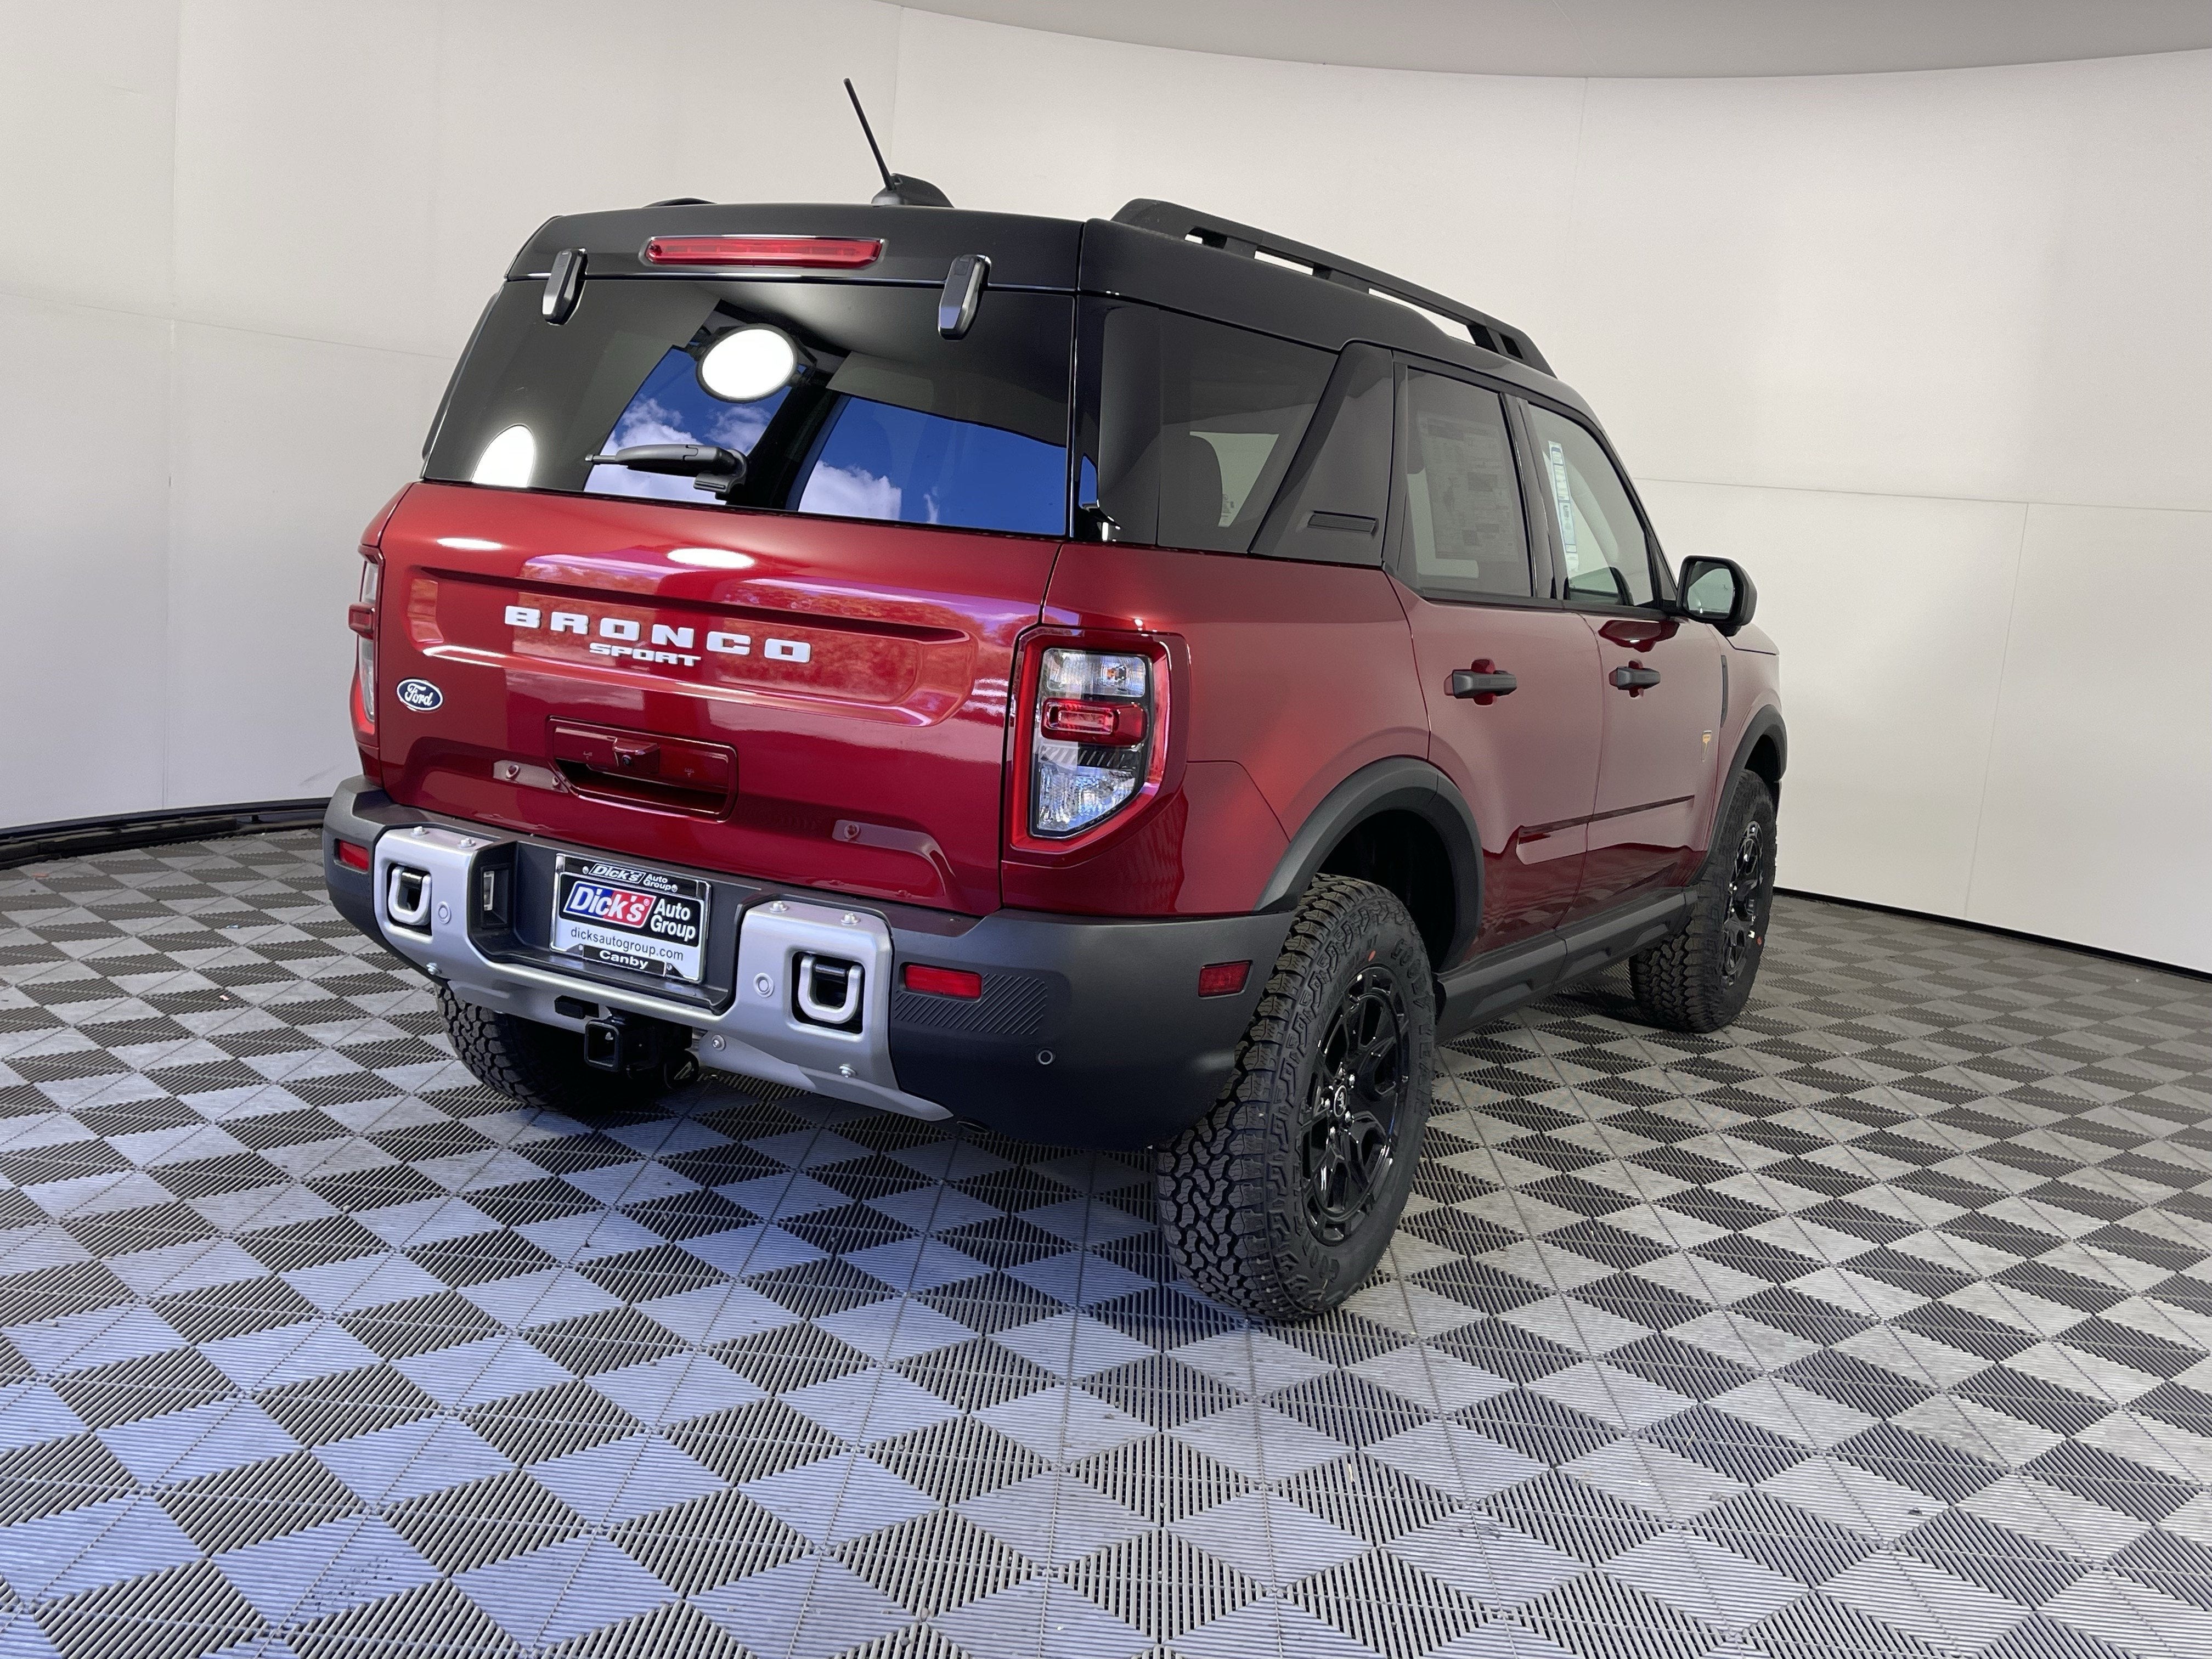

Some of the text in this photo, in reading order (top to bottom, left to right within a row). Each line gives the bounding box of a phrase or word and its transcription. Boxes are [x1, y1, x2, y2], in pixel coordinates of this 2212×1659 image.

[504, 605, 811, 664] BRONCO
[589, 642, 701, 667] SPORT
[404, 683, 434, 707] Ford
[642, 878, 673, 891] Group
[646, 873, 668, 884] Auto
[569, 886, 646, 923] Dick's
[653, 898, 691, 921] Auto
[650, 915, 696, 942] Group
[571, 927, 684, 961] dicksautogroup.com
[599, 949, 648, 970] Canby
